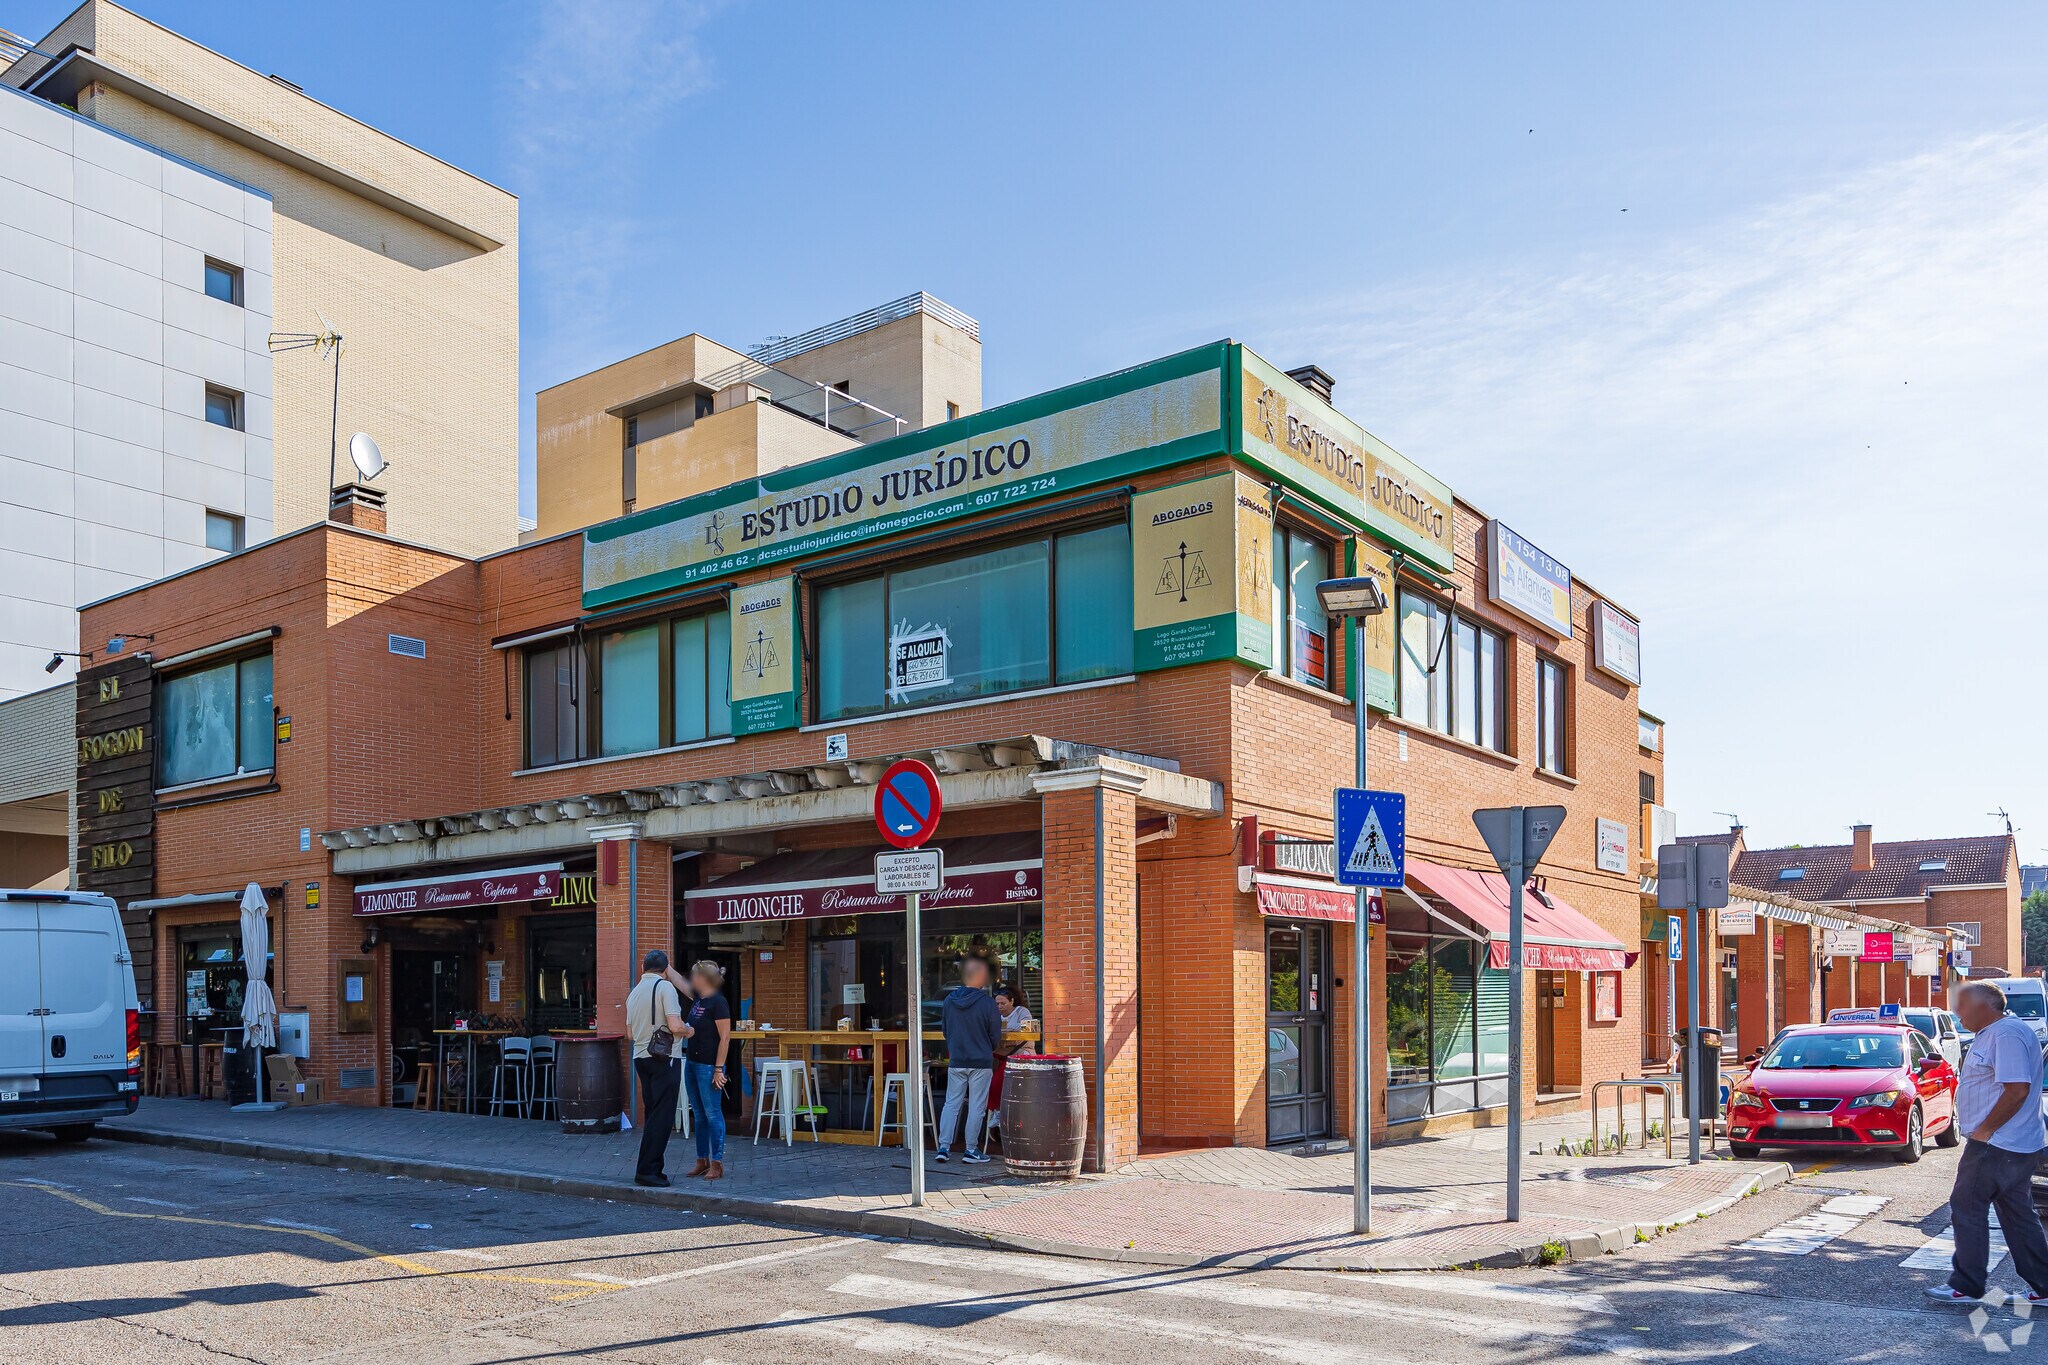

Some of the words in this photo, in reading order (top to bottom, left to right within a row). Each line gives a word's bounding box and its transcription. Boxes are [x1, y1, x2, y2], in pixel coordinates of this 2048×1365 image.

[1287, 415, 1365, 490] ESTUDIO
[1370, 476, 1443, 538] JURÍDICO
[740, 485, 863, 542] ESTUDIO
[871, 439, 1032, 507] JURÍDICO
[1152, 501, 1213, 525] ABOGADOS
[685, 567, 697, 579] 91
[700, 563, 718, 576] 402
[721, 558, 733, 570] 46
[736, 555, 749, 566] 62
[759, 501, 964, 562] dcsestudiojuridico@infonegocio.com
[976, 491, 999, 506] 607
[1003, 484, 1028, 499] 722
[1032, 476, 1057, 492] 724
[1498, 528, 1512, 546] 91
[1516, 539, 1537, 562] 154
[1540, 556, 1553, 572] 13
[1555, 567, 1568, 582] 08
[740, 597, 781, 614] ABOGADOS
[897, 645, 907, 661] SE
[907, 640, 943, 659] ALQUILA
[1164, 653, 1177, 662] 607
[1178, 651, 1190, 659] 904
[1192, 649, 1203, 657] 501
[1173, 643, 1186, 651] 402
[1197, 639, 1206, 647] 62
[100, 676, 123, 703] EL
[80, 726, 144, 763] FOGON
[98, 786, 125, 814] DE
[90, 841, 133, 870] FILO
[894, 856, 920, 865] EXCEPTO
[880, 865, 899, 874] CARGA
[904, 863, 936, 872] DESCARGA
[885, 872, 922, 881] LABORABLES
[361, 890, 418, 912] LIMONCHE
[424, 887, 472, 905] Restaurante
[481, 880, 519, 903] Cafetería
[717, 894, 805, 921] LIMONCHE
[821, 889, 896, 911] Restaurante
[1006, 887, 1038, 899] HISPANO
[1260, 889, 1307, 912] LIMONCHE
[1671, 921, 1679, 954] P
[1833, 1013, 1876, 1021] UNIVERSAL
[1884, 1006, 1893, 1015] L
